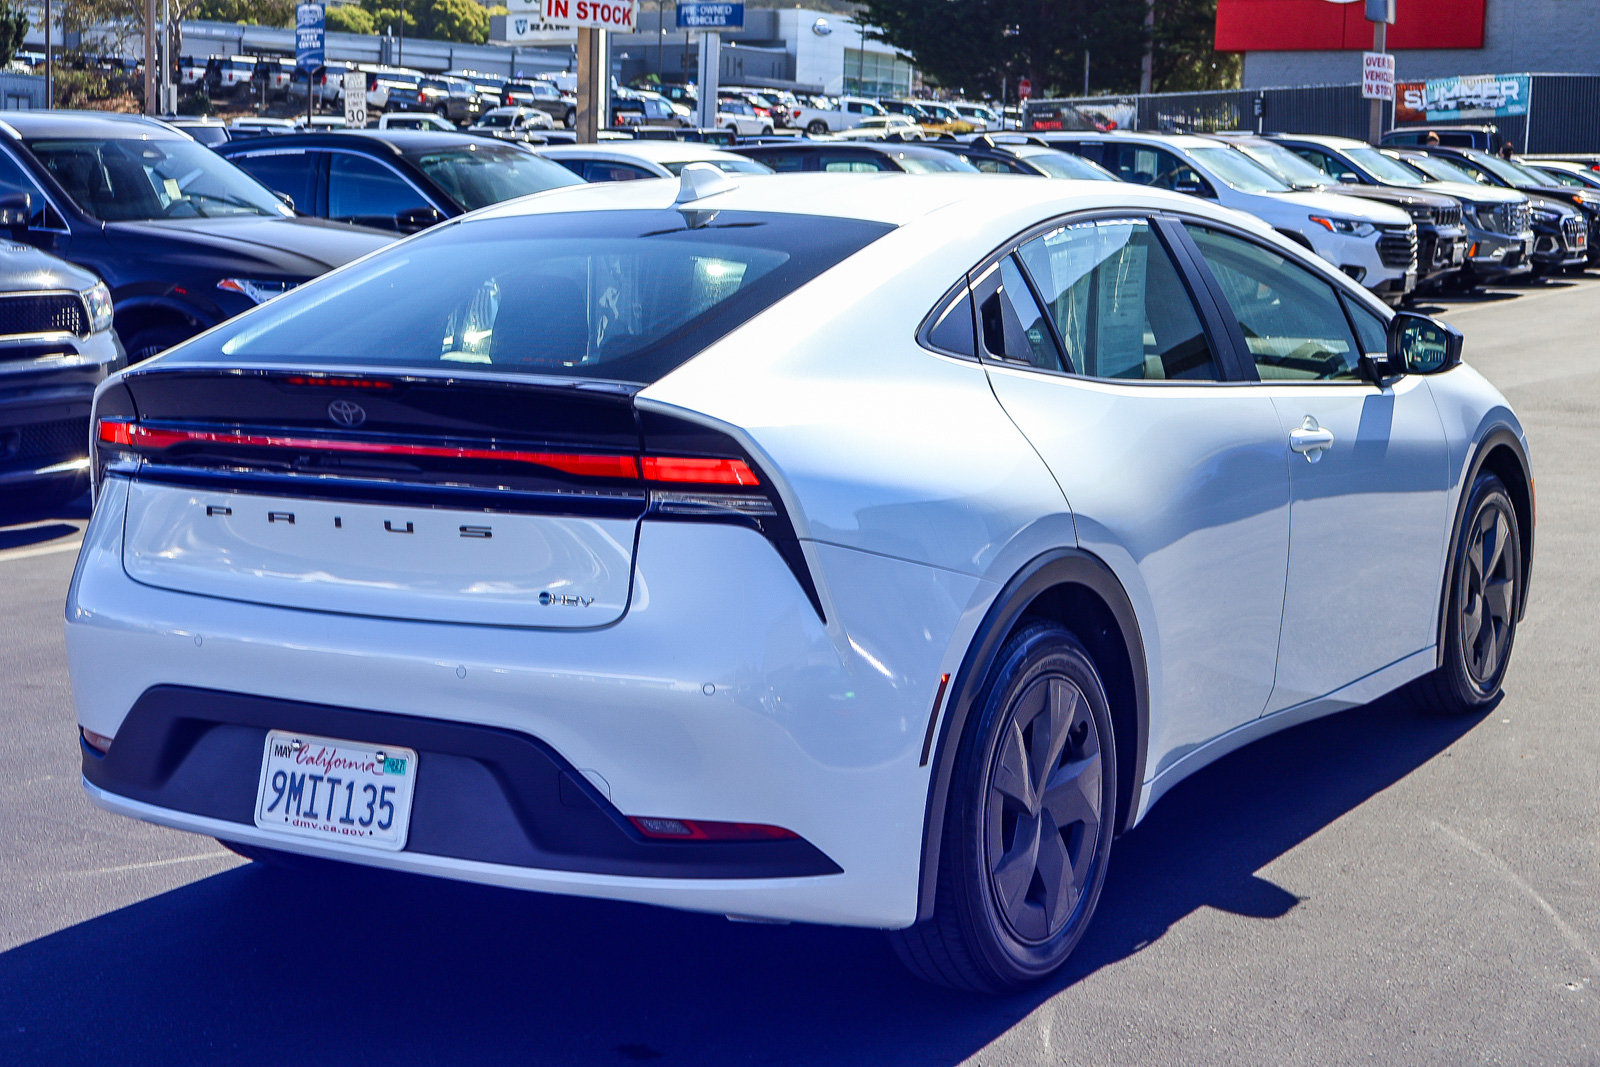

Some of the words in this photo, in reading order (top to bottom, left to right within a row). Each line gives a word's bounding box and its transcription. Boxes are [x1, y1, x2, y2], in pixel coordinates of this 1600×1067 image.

[547, 0, 569, 18] IN
[576, 1, 632, 26] STOCK
[686, 15, 727, 25] VEHICLES
[1365, 56, 1386, 68] OVER
[1404, 80, 1520, 110] SUMMER
[348, 109, 365, 122] 30
[206, 505, 493, 538] PRIUS
[274, 744, 293, 759] MAY
[296, 744, 384, 776] California
[267, 770, 396, 830] 9MIT135
[292, 818, 365, 837] dmv.ca.gov
